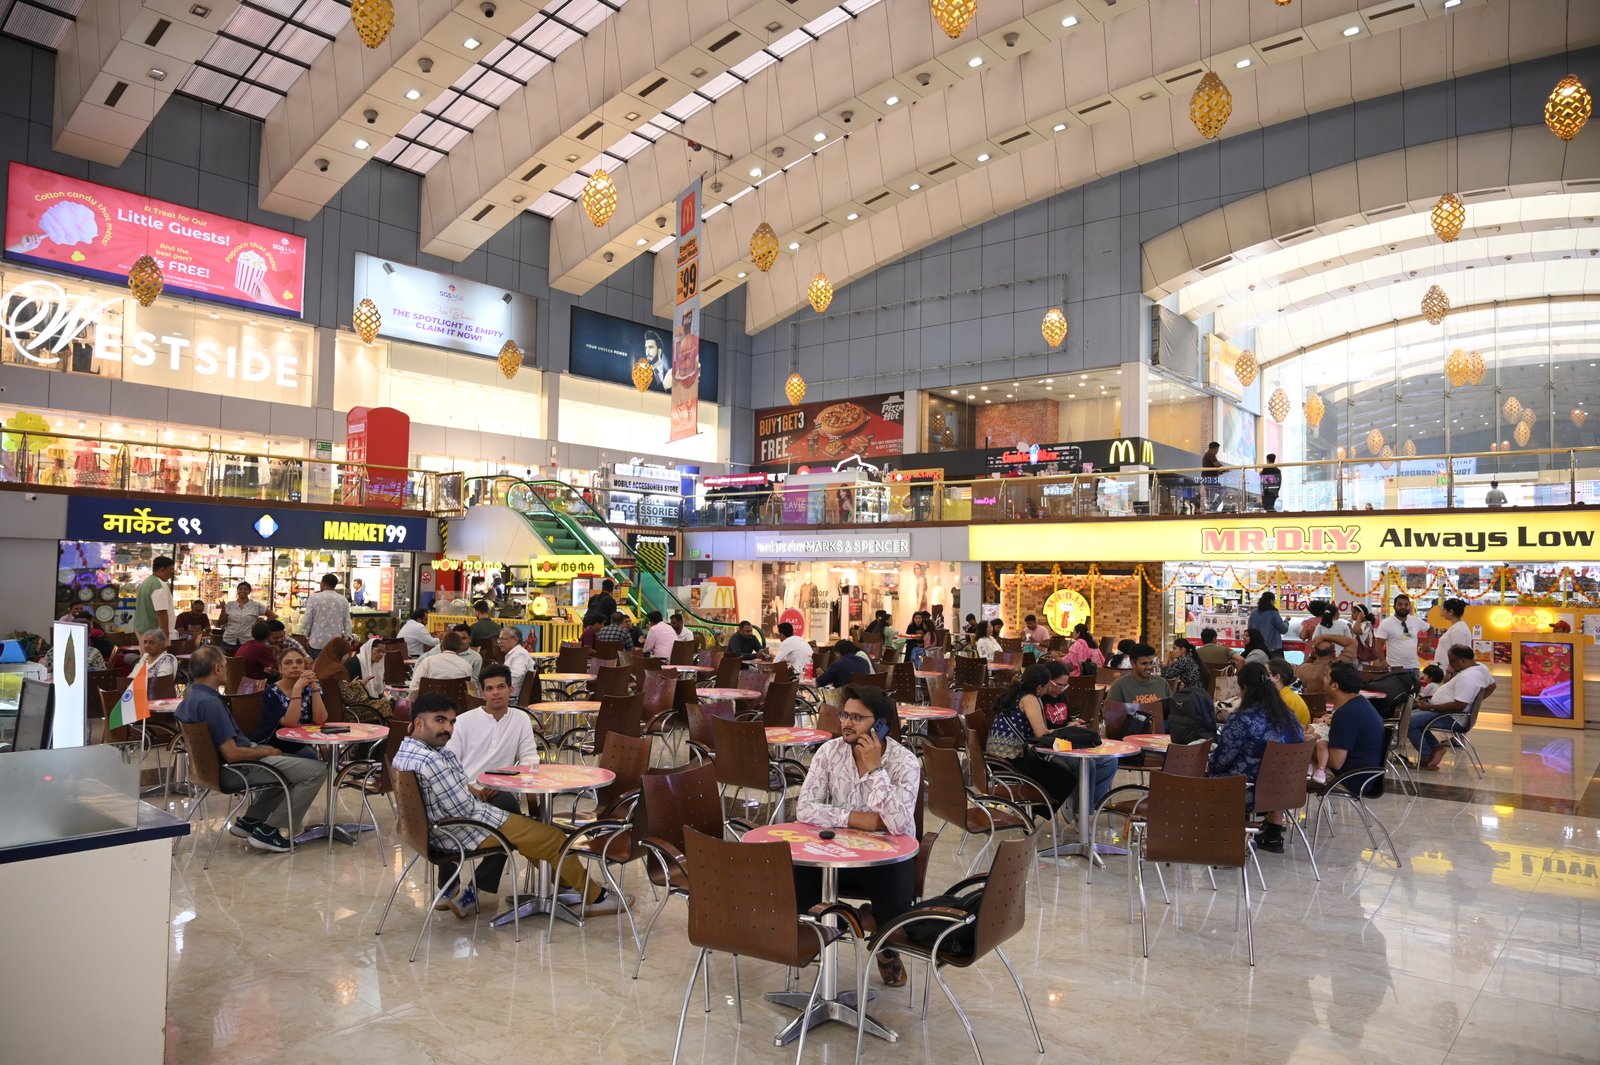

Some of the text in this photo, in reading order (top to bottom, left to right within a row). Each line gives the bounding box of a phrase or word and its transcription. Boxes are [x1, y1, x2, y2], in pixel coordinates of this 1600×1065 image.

[34, 191, 65, 201] Cotton
[67, 191, 97, 205] candy
[98, 204, 111, 221] that
[153, 208, 176, 219] Treat
[178, 214, 189, 223] for
[191, 217, 208, 227] Our
[117, 208, 230, 246] Little Guests!
[155, 249, 192, 263] best part?
[160, 243, 189, 255] And the
[250, 242, 267, 252] that
[169, 261, 210, 279] FREE!
[392, 308, 504, 338] THE SPOTLIGHT IS EMPTY
[416, 322, 444, 334] CLAIM
[457, 331, 482, 341] NOW!
[883, 411, 899, 421] Hut
[761, 436, 789, 461] FREE
[613, 479, 679, 493] MOBILE ACCESSORIES STORE
[614, 503, 679, 517] ACCSSORIES
[784, 500, 806, 510] LAVIE
[103, 508, 202, 535] मार्केट ९९
[806, 539, 843, 552] MARKS
[844, 540, 851, 552] &
[853, 538, 908, 553] SPENCER
[1380, 526, 1595, 552] Always Low
